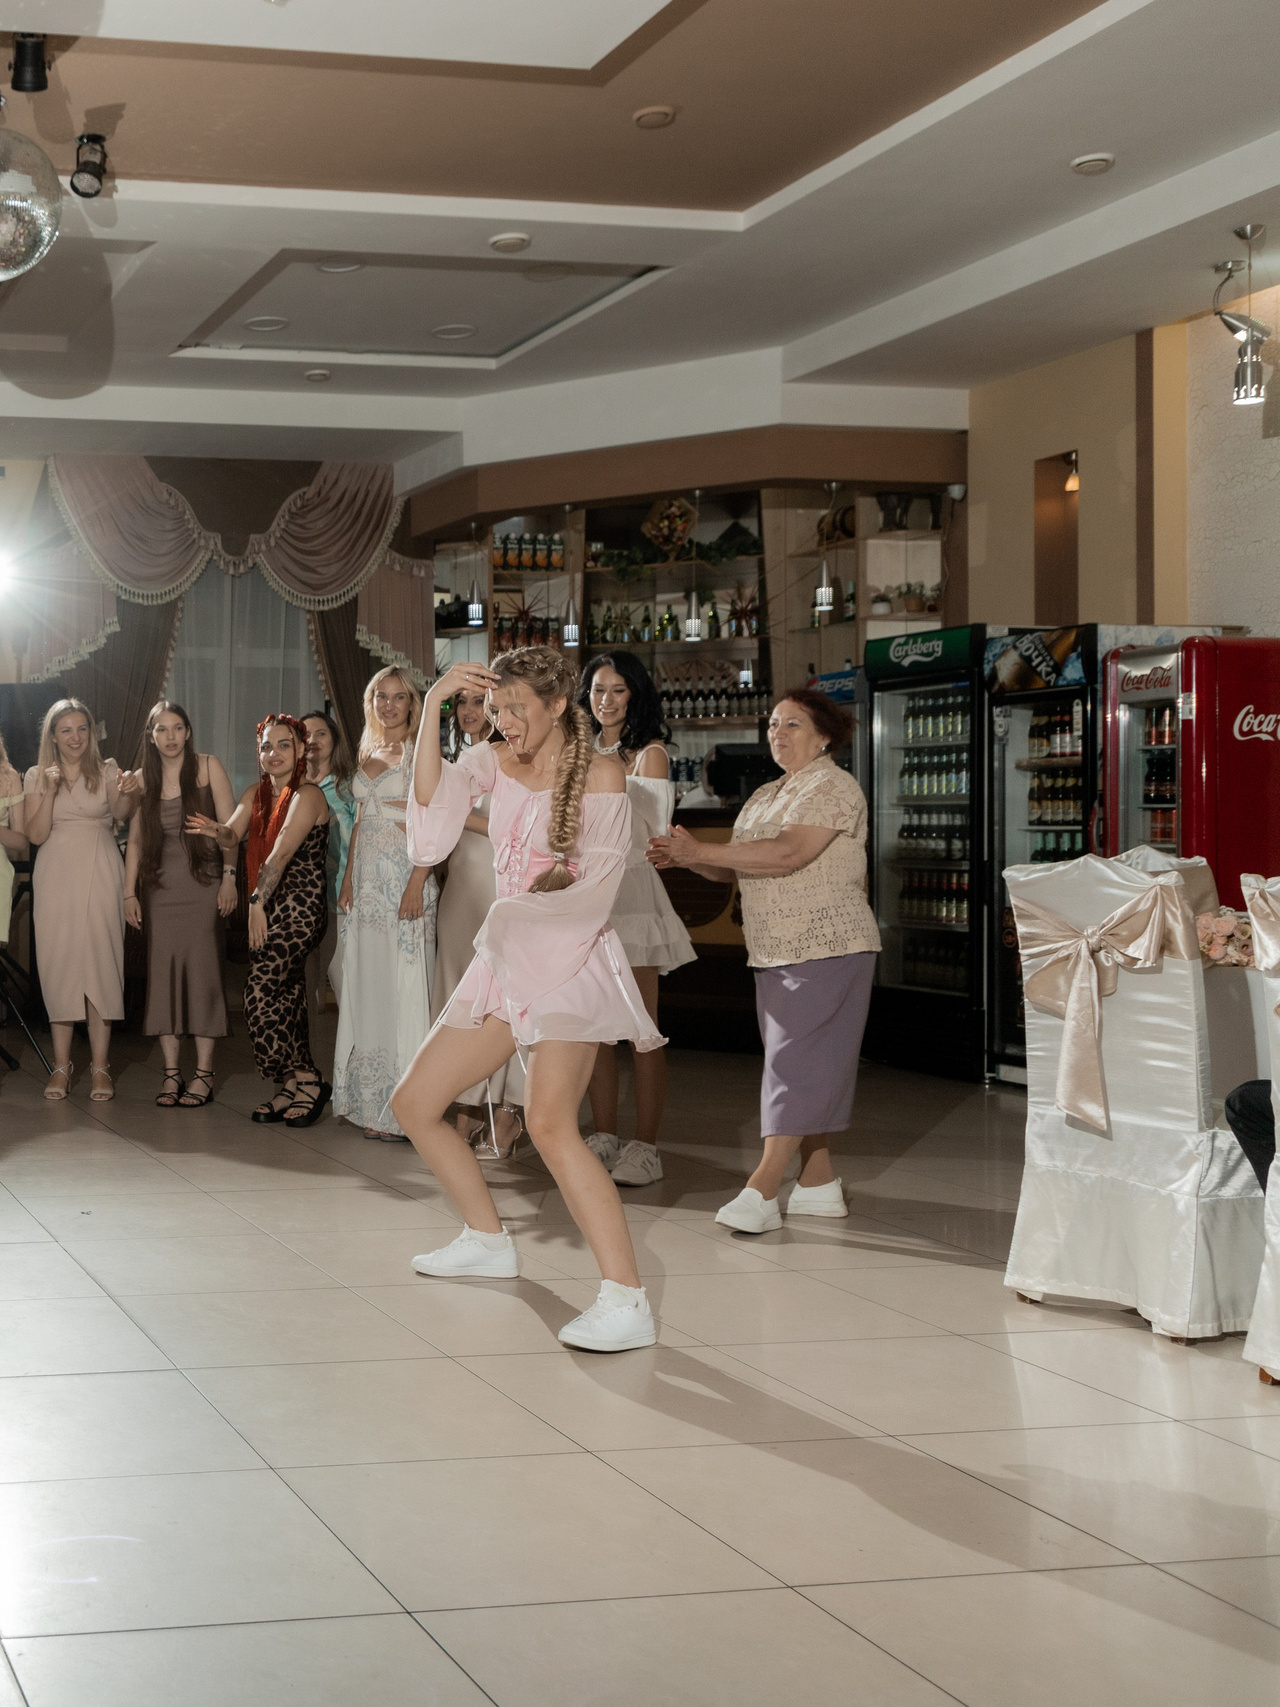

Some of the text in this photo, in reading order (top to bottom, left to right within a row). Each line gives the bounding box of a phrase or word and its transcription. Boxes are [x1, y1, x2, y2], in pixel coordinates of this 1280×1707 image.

[889, 636, 943, 667] Carlsberg
[1014, 633, 1057, 687] БОЧКА
[816, 676, 856, 693] PEPS
[1121, 666, 1173, 692] Coca-Cola
